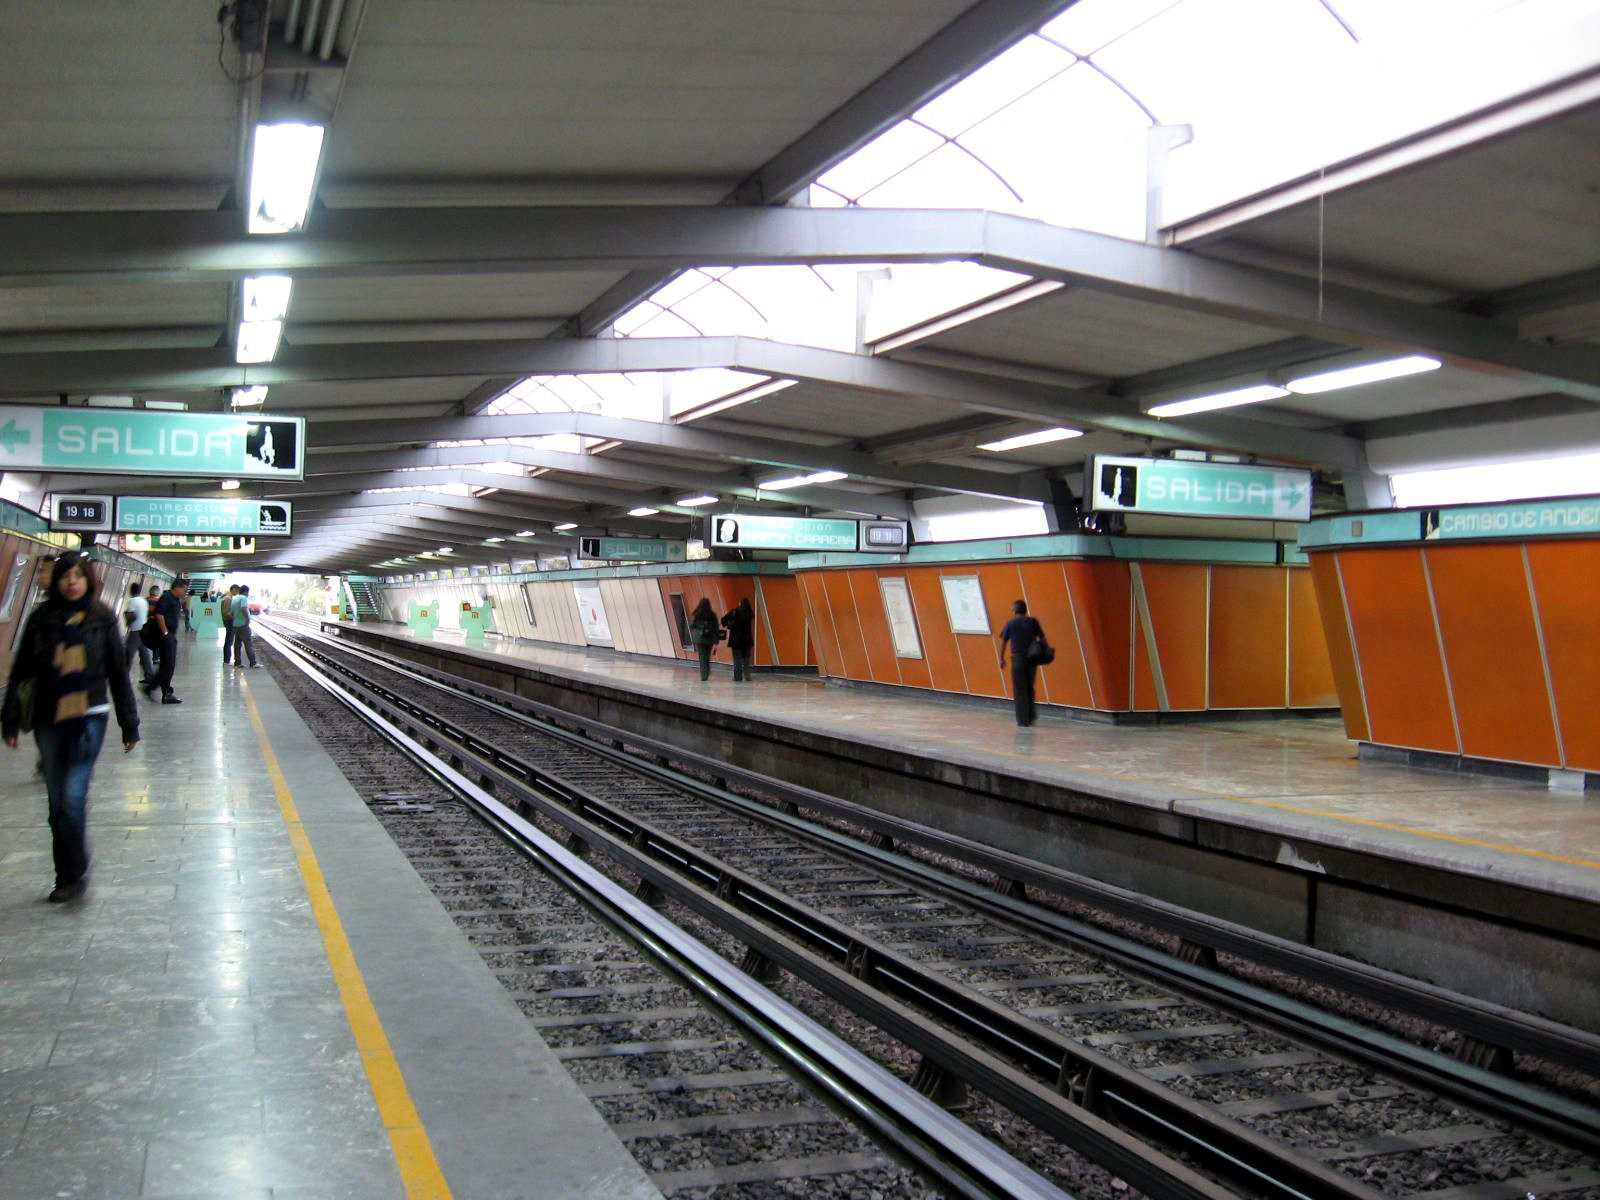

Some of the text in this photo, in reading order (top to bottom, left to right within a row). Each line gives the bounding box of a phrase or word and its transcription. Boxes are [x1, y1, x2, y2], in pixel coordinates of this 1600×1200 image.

[57, 425, 232, 456] SALIDA
[1146, 476, 1267, 505] SALIDA
[65, 505, 95, 518] 19 18
[150, 503, 229, 514] DIRECCIO
[123, 514, 253, 529] SANTA ANITA
[1442, 511, 1507, 533] CAMBIO
[1511, 509, 1537, 529] DE
[160, 535, 222, 547] SALIDA
[605, 543, 663, 556] SALIDA
